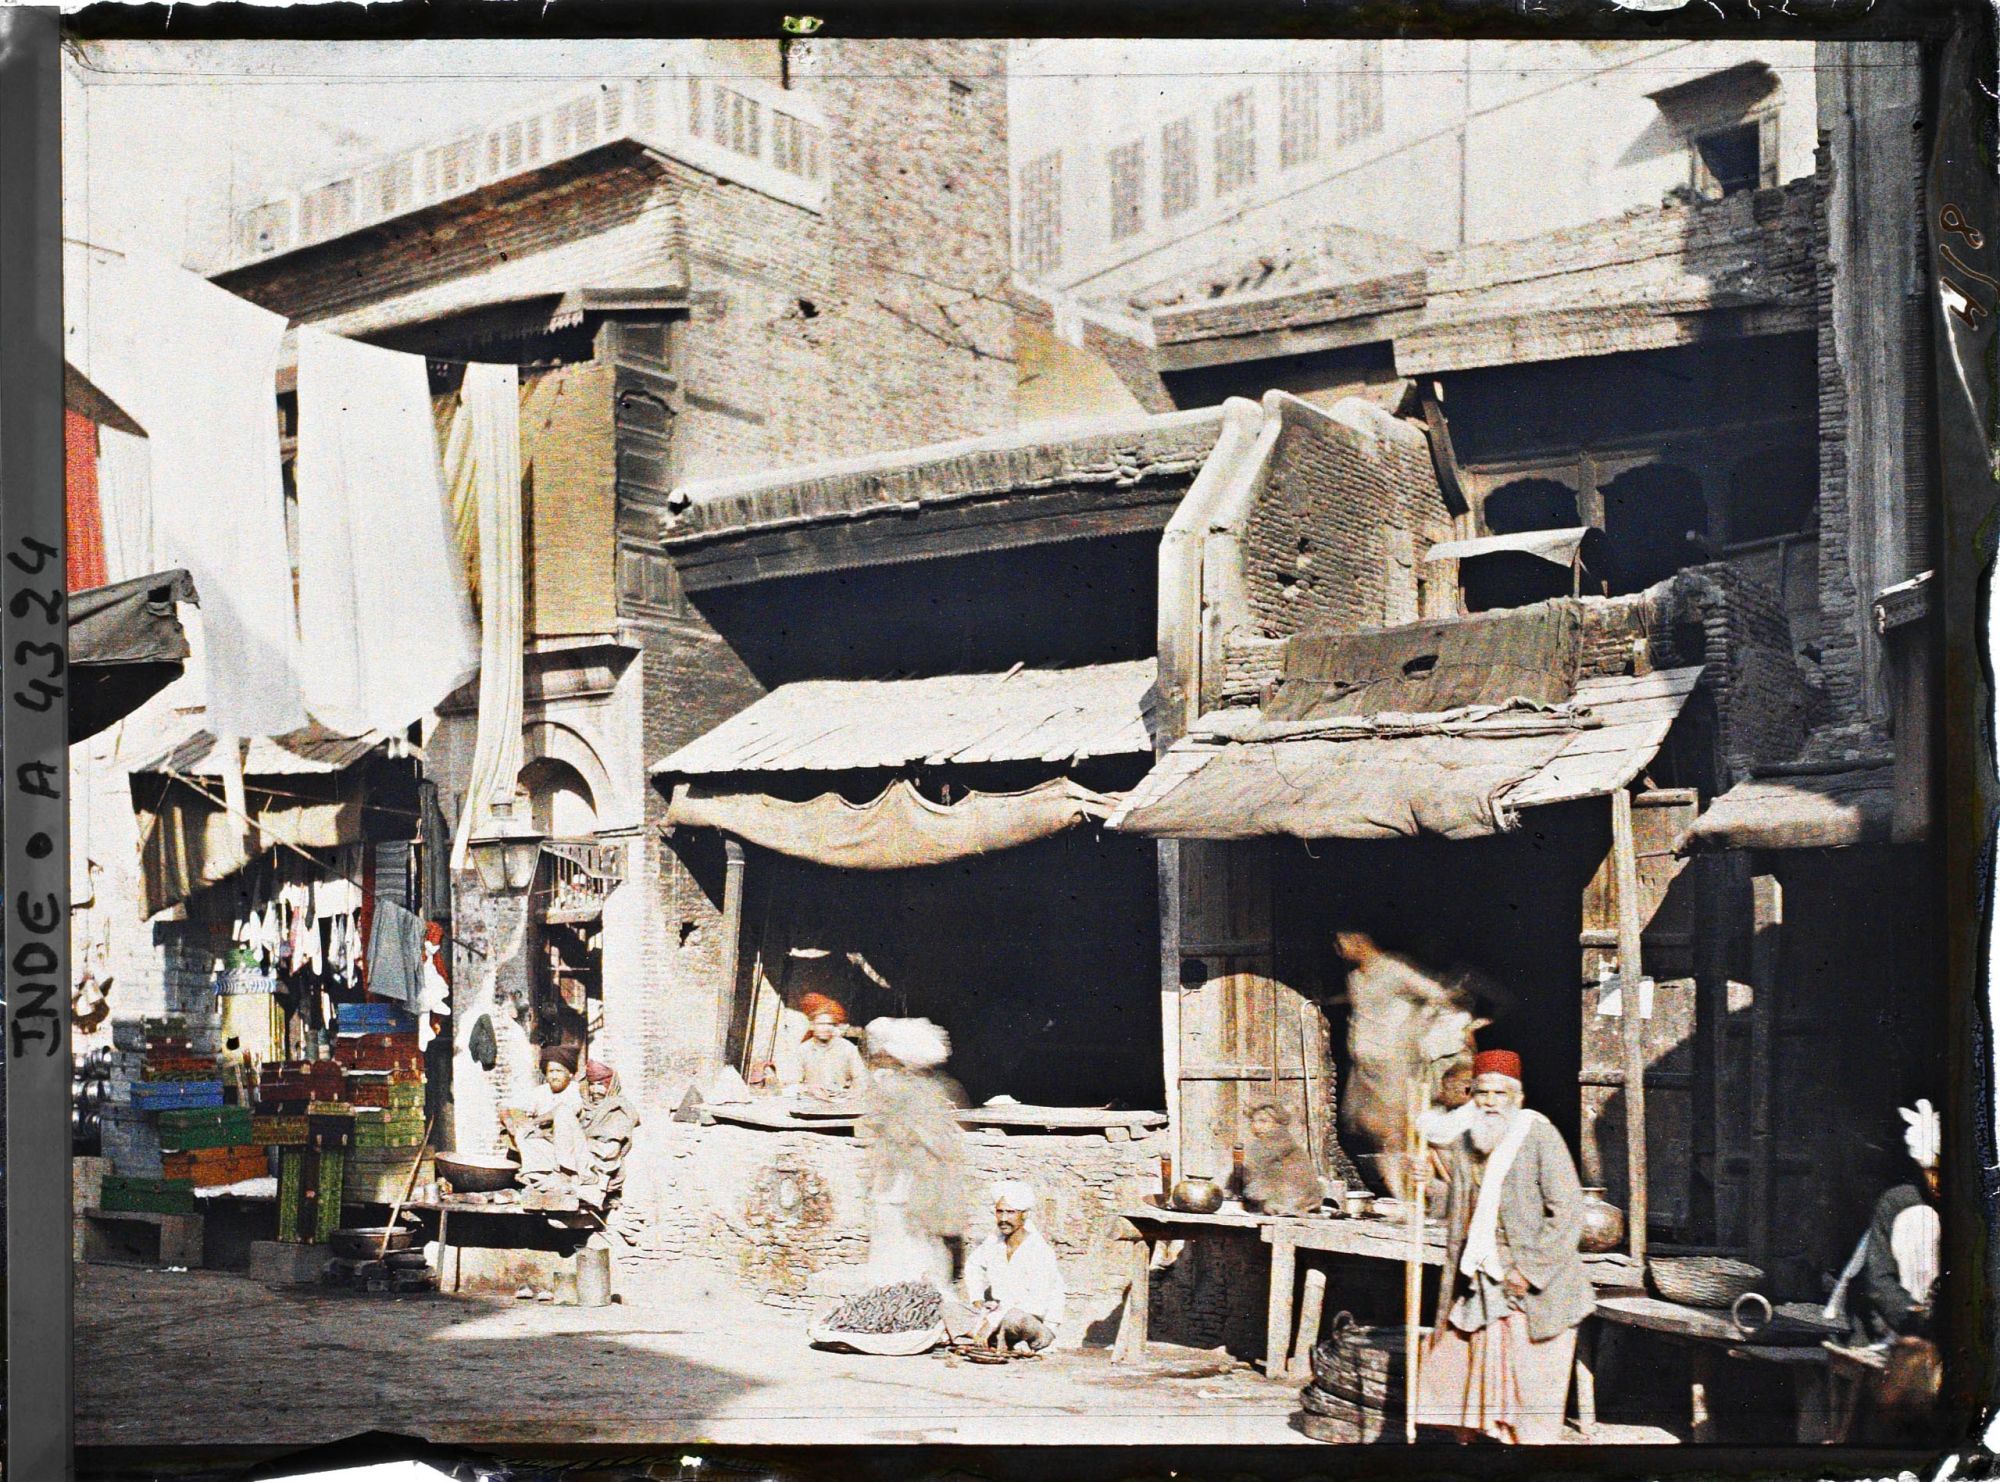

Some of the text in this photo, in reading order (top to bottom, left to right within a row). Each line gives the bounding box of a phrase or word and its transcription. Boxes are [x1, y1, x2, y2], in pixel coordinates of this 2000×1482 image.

[7, 537, 64, 1058] INDE A 4324
